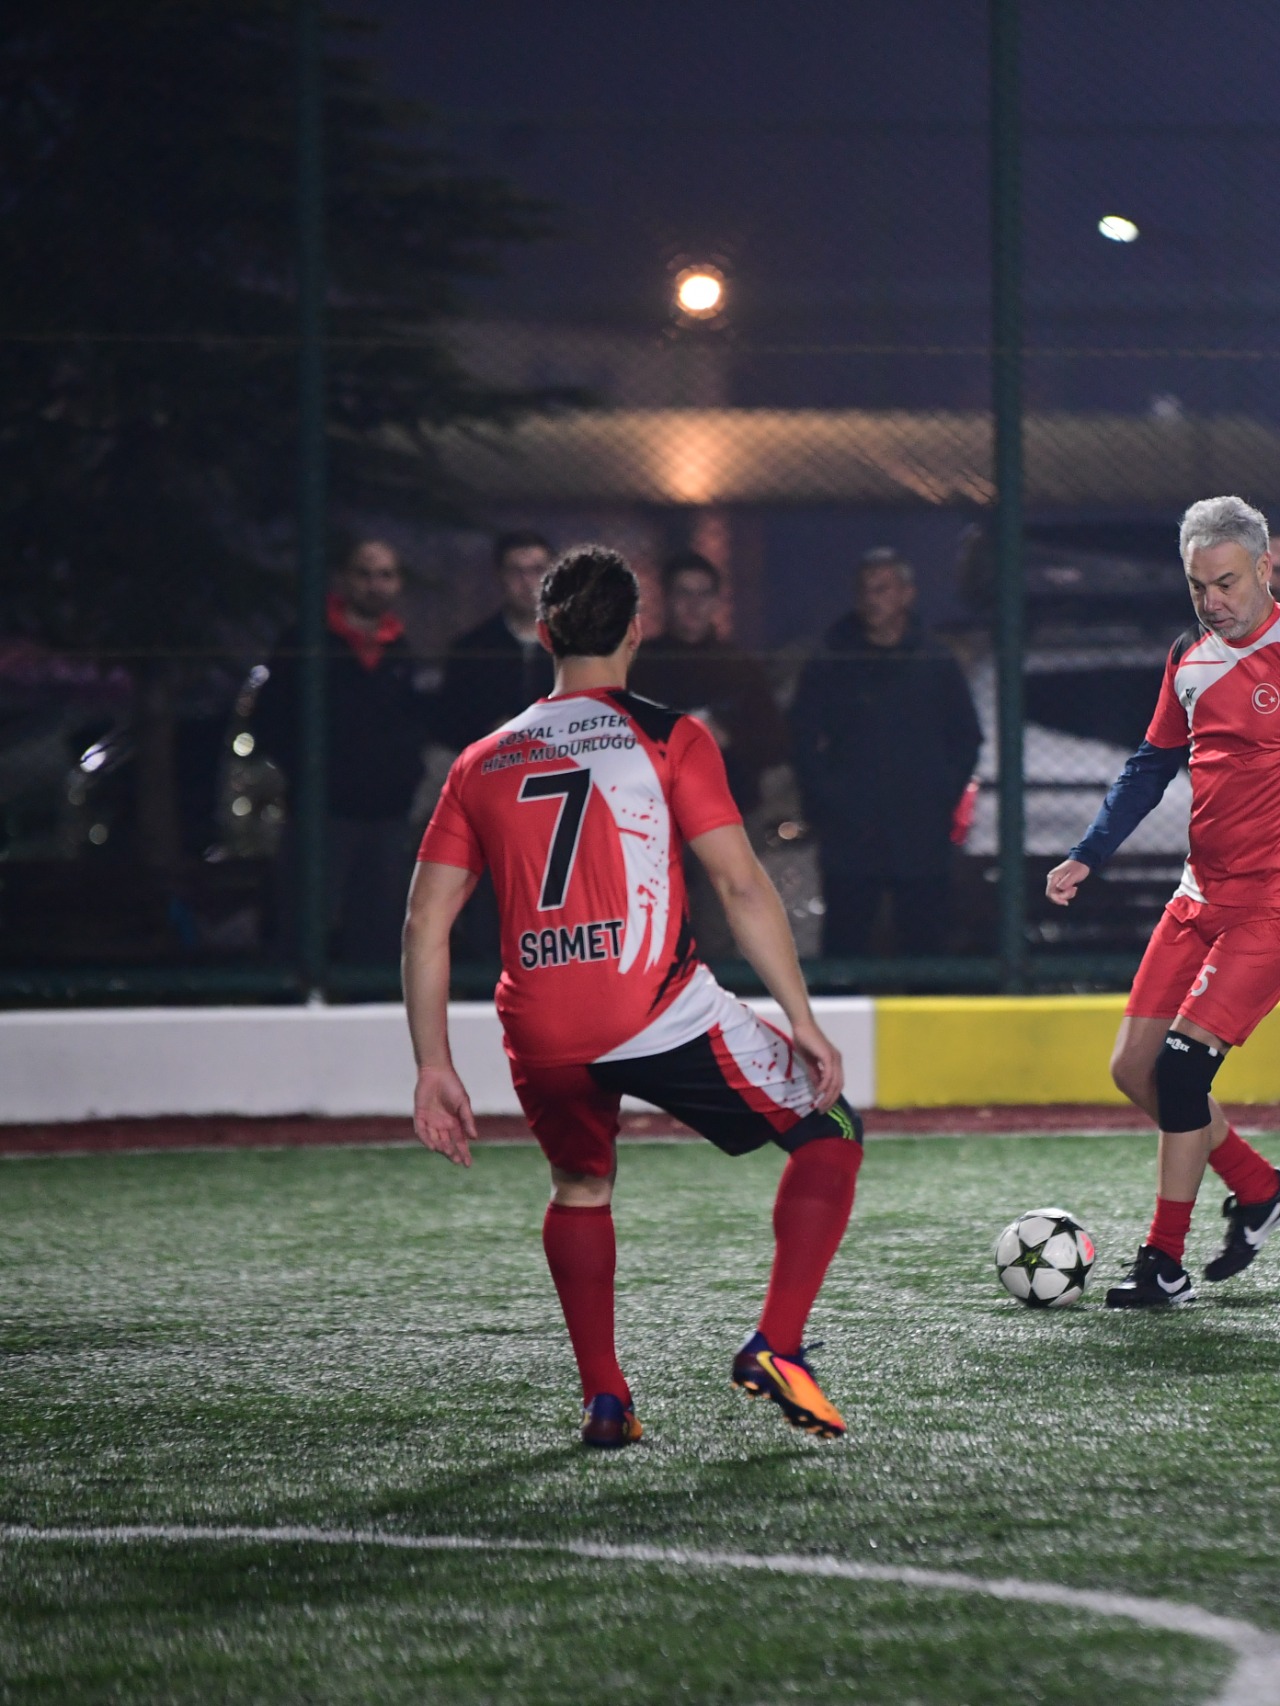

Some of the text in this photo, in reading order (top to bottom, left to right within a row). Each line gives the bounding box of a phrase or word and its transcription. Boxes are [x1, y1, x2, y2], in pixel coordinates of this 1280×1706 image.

[497, 726, 554, 749] SOSYAL
[568, 715, 630, 735] DESTEK
[517, 767, 592, 912] 7
[520, 919, 624, 970] SAMET
[1191, 964, 1217, 997] 5
